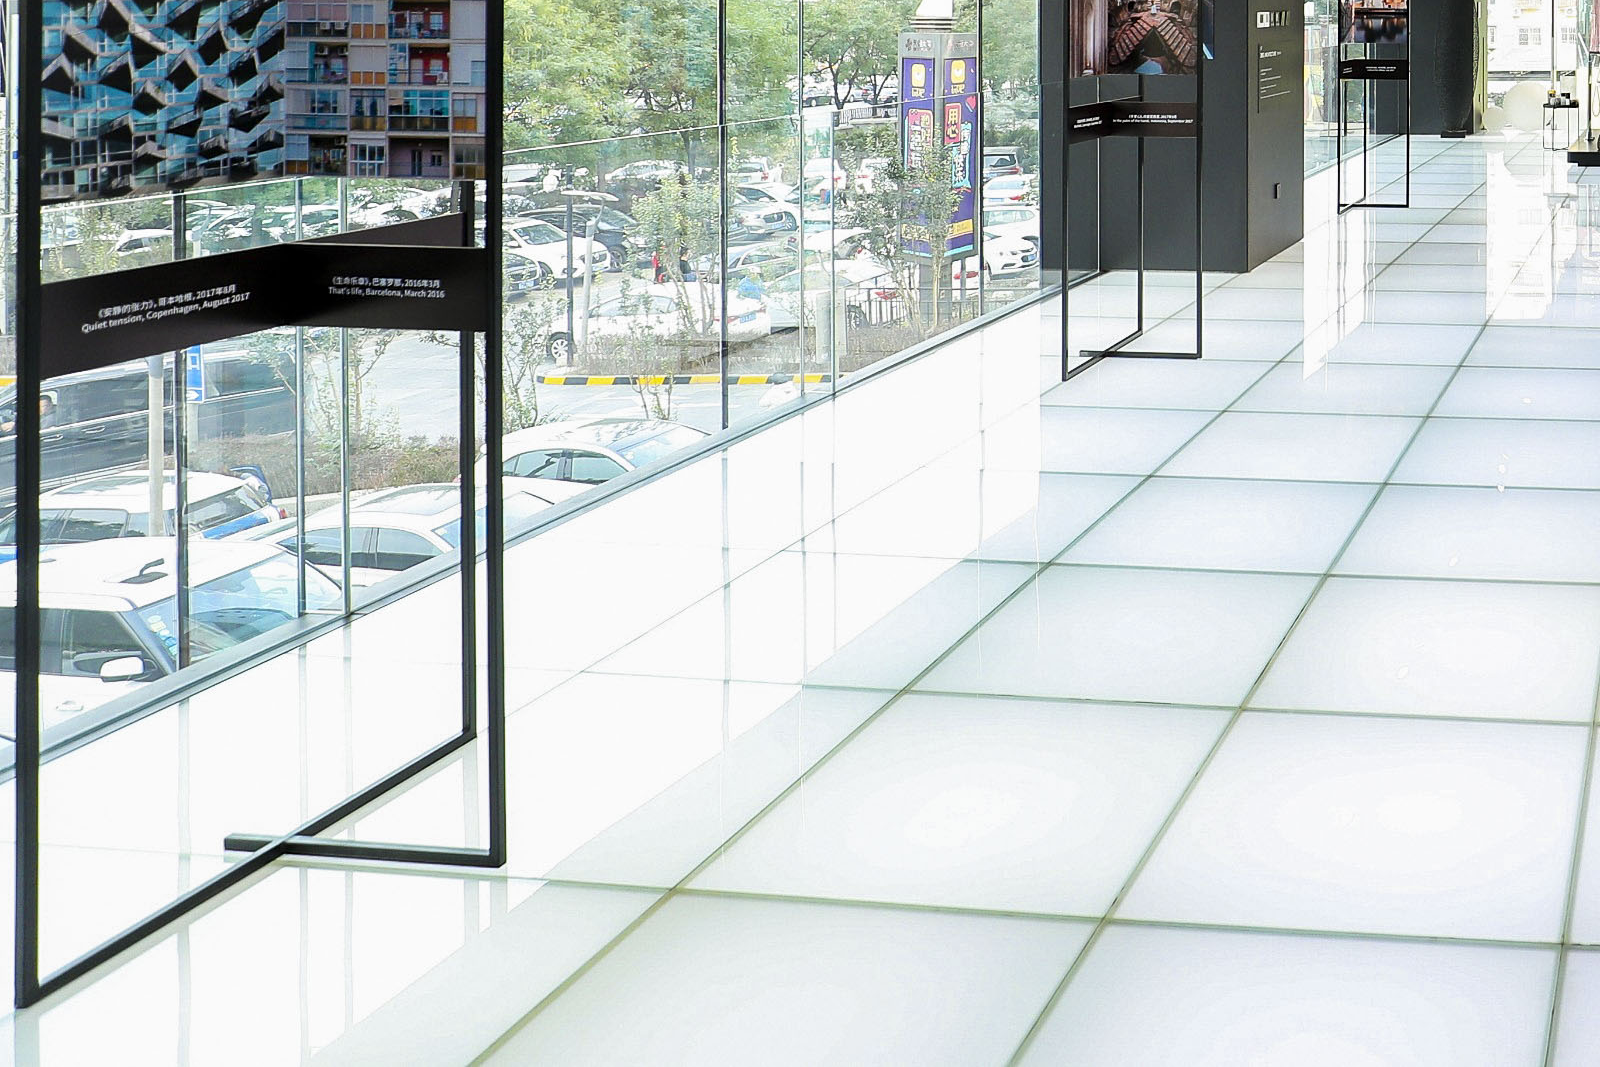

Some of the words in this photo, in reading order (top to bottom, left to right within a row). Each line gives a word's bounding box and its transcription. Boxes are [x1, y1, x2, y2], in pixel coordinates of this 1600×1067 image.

[365, 288, 404, 298] Barcelona,
[404, 289, 426, 297] March
[427, 290, 445, 298] 2016
[81, 320, 108, 334] Quiet
[108, 314, 144, 328] tension,
[146, 301, 201, 320] Copenhagen,
[202, 297, 230, 309] August
[230, 292, 250, 304] 2017
